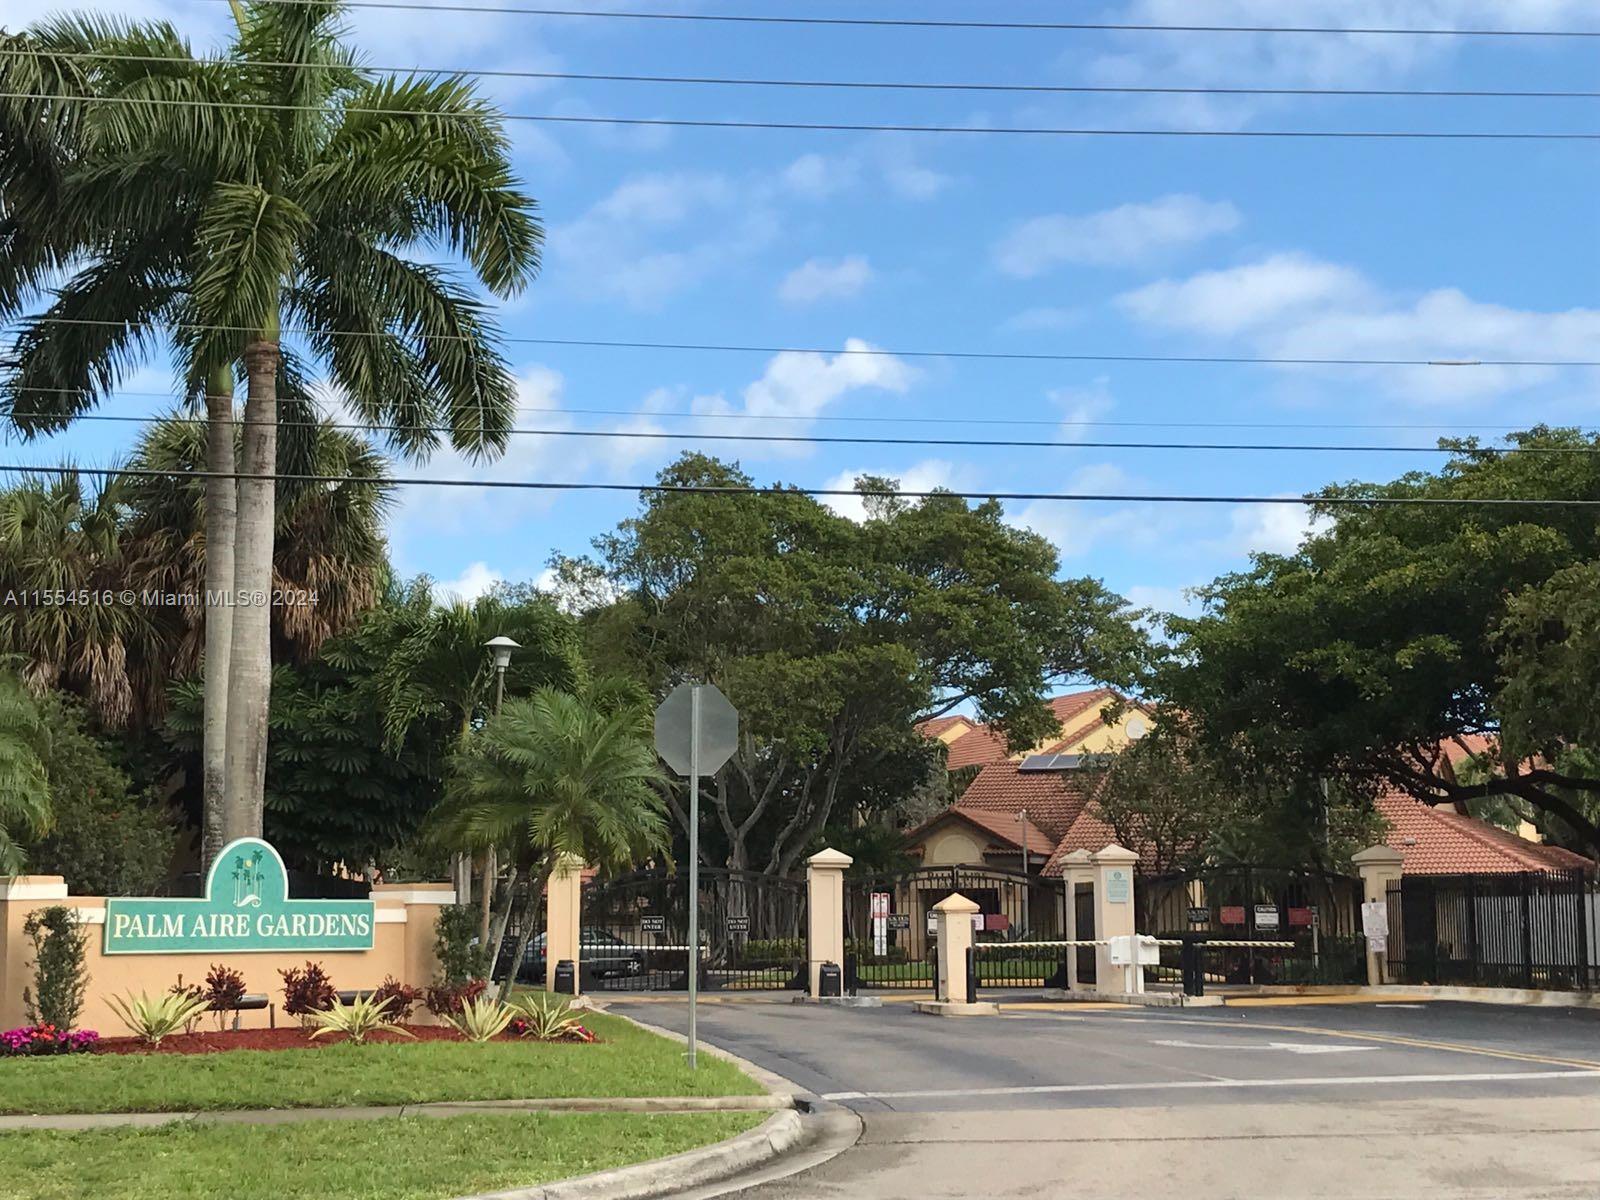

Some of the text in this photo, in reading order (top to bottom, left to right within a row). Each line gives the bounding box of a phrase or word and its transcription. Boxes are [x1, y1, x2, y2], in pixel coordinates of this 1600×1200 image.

[113, 913, 371, 938] PALM AIRE GARDENS
